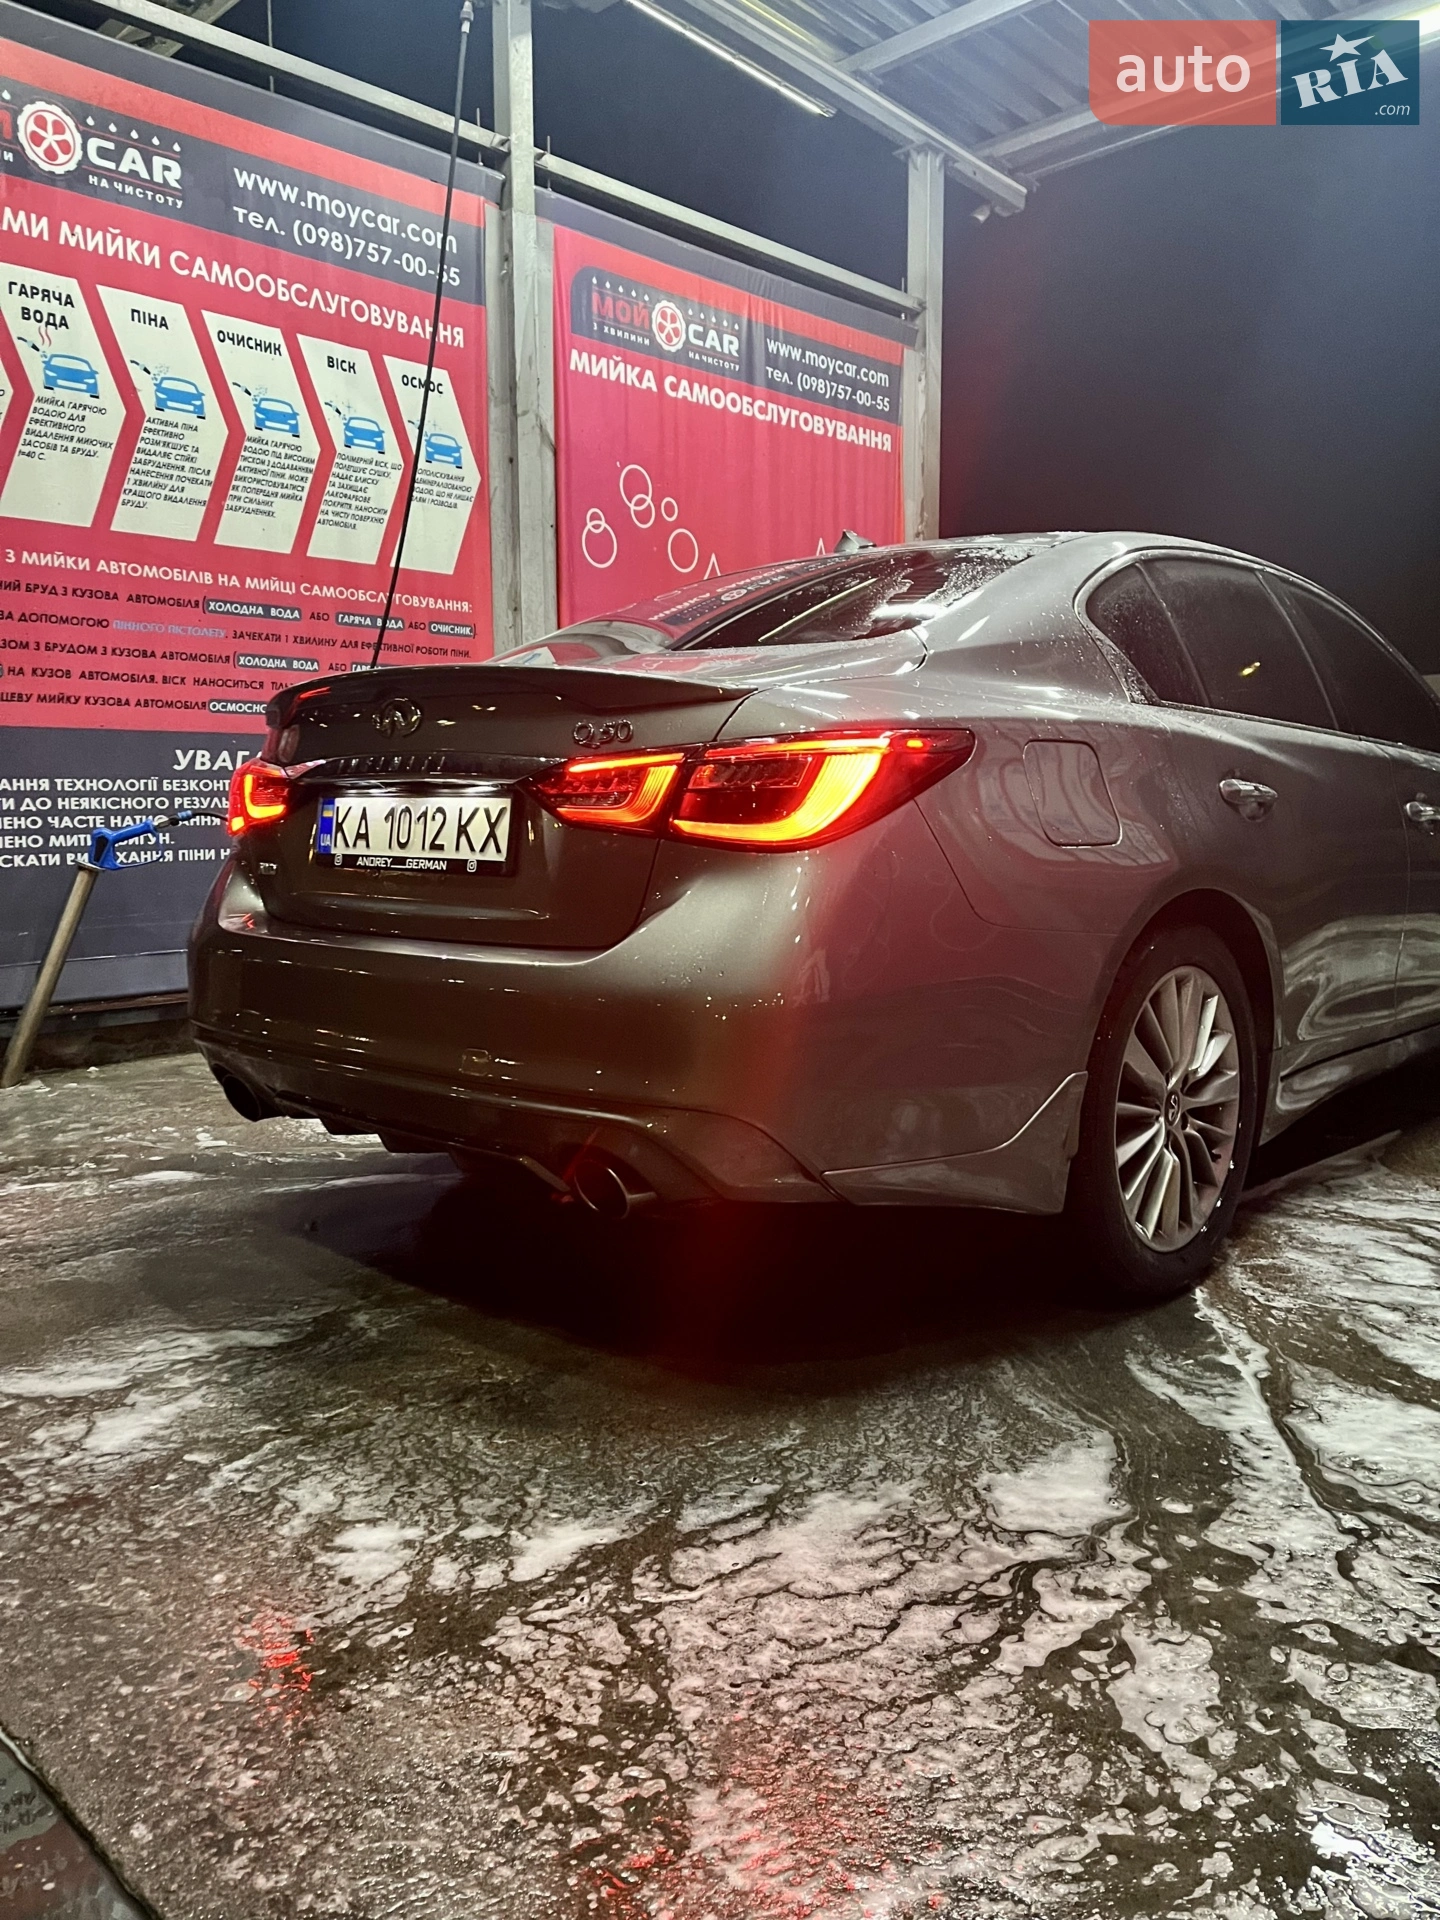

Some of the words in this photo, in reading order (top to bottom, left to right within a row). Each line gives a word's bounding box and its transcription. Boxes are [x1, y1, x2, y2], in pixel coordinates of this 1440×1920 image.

[87, 137, 182, 189] CAR
[89, 174, 109, 188] НА
[114, 181, 183, 208] ЧИСТОТУ
[234, 167, 457, 253] www.moycar.com
[233, 206, 285, 235] тел.
[293, 219, 460, 287] (098)757-00-55
[0, 206, 49, 241] МИ
[59, 221, 160, 269] МИЙКИ
[170, 250, 464, 348] САМООБСЛУГОВУВАННЯ
[8, 281, 75, 308] ГАРЯЧА
[21, 307, 69, 329] ВОДА
[131, 308, 169, 330] ПІНА
[591, 291, 649, 330] МОЙ
[688, 323, 739, 357] CAR
[217, 330, 282, 356] ОЧИСНИК
[603, 326, 650, 346] ХВИЛИНИ
[688, 351, 700, 360] НА
[702, 355, 740, 371] ЧИСТОТУ
[327, 355, 357, 374] ВІСК
[767, 338, 889, 388] www.moycar.com
[401, 374, 443, 394] ОСМОС
[766, 366, 793, 385] тел.
[797, 372, 890, 412] (098)757-00-55
[35, 396, 65, 408] МИЙКА
[68, 401, 107, 415] ГАРЯЧОЮ
[570, 349, 658, 393] МИЙКА
[664, 376, 892, 452] САМООБСЛУГОВУВАННЯ
[32, 406, 66, 419] ВОДОЮ
[67, 413, 86, 422] ДЛЯ
[146, 417, 179, 429] АКТИВНА
[181, 423, 198, 432] ПІНА
[29, 417, 86, 433] ЕФЕКТИВНОГО
[143, 426, 185, 440] ЕФЕКТИВНО
[21, 438, 57, 451] ЗАСОБІВ
[60, 445, 68, 453] ТА
[25, 428, 74, 442] ВИДАЛЕННЯ
[76, 437, 114, 449] МИЮЧИХ
[191, 445, 199, 453] ТА
[136, 447, 172, 460] ВИДАЛЯЄ
[243, 445, 270, 456] ВОДОЮ
[129, 467, 174, 480] НАНЕСЕННЯ
[176, 475, 213, 487] ПОЧЕКАТИ
[188, 466, 211, 476] ПІСЛЯ
[133, 478, 168, 490] ХВИЛИНУ
[169, 484, 185, 493] ДЛЯ
[122, 488, 162, 500] КРАЩОГО
[163, 494, 207, 507] ВИДАЛЕННЯ
[21, 551, 90, 571] МИЙКИ
[96, 559, 213, 584] АВТОМОБІЛІВ
[218, 573, 240, 588] НА
[245, 576, 295, 595] МИЙЦІ
[300, 583, 473, 613] САМООБСЛГОВУВАННЯ:
[25, 583, 58, 596] БРУД
[72, 587, 119, 601] КУЗОВА
[126, 593, 199, 609] АВТОМОБІЛЯ
[270, 608, 300, 619] ВОДА
[309, 612, 330, 622] АБО
[338, 614, 372, 626] ГАРЯЧА
[408, 622, 426, 631] АБО
[18, 612, 109, 628] ДОПОМОГОЮ
[232, 630, 281, 643] ЗАЧЕКАТИ
[293, 635, 337, 648] ХВИЛИНУ
[340, 639, 359, 650] ДЛЯ
[415, 646, 448, 657] РОБОТИ
[45, 642, 97, 655] БРУДОМ
[111, 647, 156, 659] КУЗОВА
[160, 651, 230, 664] АВТОМОБІЛЯ
[293, 660, 319, 671] ВОДА
[328, 663, 347, 672] АБО
[7, 666, 25, 676] НА
[31, 667, 72, 679] КУЗОВ
[79, 671, 158, 685] АВТОМОБІЛЯ.
[162, 675, 186, 685] ВІСК
[193, 677, 264, 689] НАНОСИТЬСЯ
[36, 693, 81, 705] МИЙКУ
[84, 696, 130, 707] КУЗОВА
[134, 699, 207, 711] АВТОМОБІЛЯ
[574, 719, 634, 749] Q50
[54, 777, 158, 791] ТЕХНОЛОГІЇ
[20, 797, 52, 811] ДО
[58, 797, 169, 810] НЕЯКІСНОГО
[47, 816, 105, 828] ЧАСТЕ
[384, 806, 447, 851] 1012
[455, 806, 507, 853] KX
[320, 834, 331, 846] UA
[0, 854, 60, 867] СКАТИ
[178, 849, 215, 861] ПІНИ
